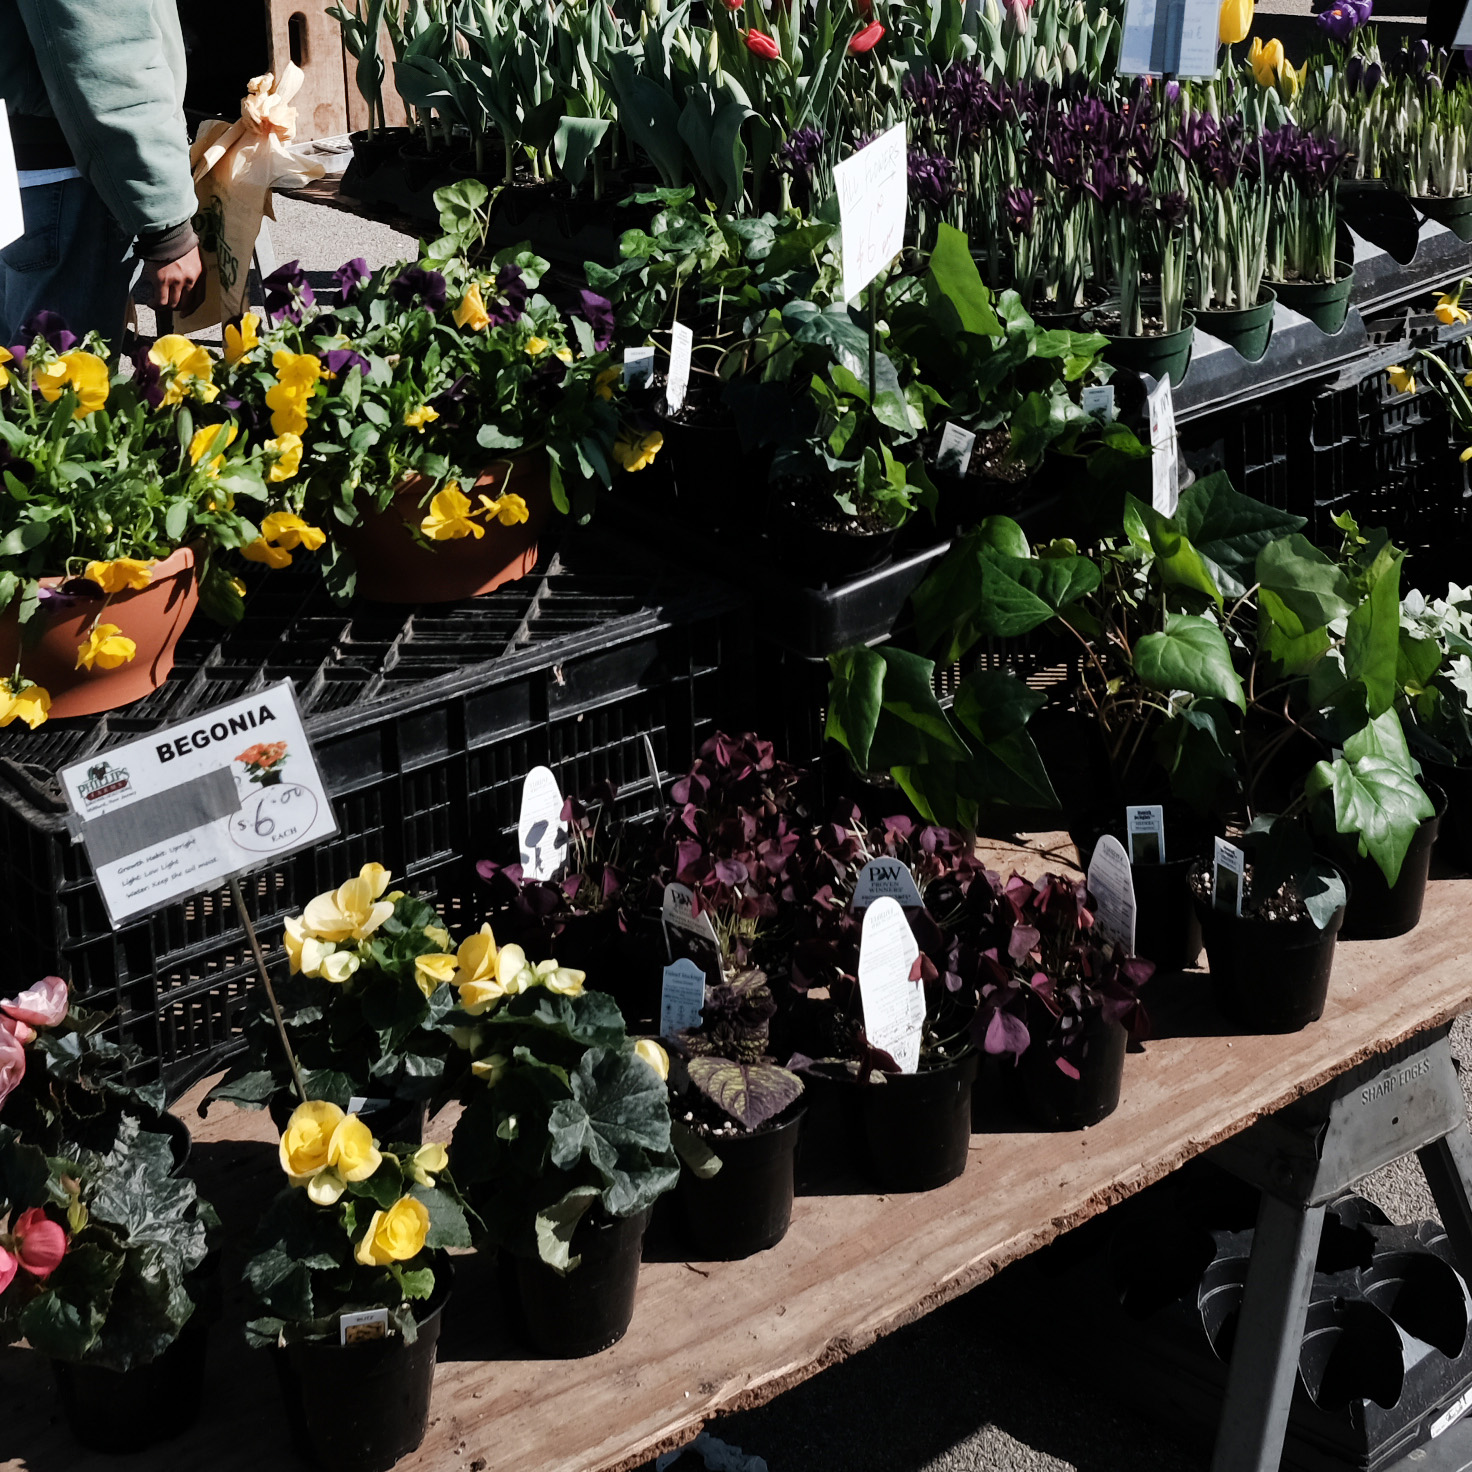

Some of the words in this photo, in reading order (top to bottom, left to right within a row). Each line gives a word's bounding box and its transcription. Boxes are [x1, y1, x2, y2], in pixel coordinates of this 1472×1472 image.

[156, 704, 276, 763] BEGONIA
[78, 768, 130, 798] PHILLIPS
[272, 827, 297, 842] EACH
[117, 860, 144, 874] Growth
[169, 838, 197, 856] Upright
[144, 867, 159, 880] Low
[161, 859, 179, 873] Light
[1361, 1077, 1397, 1105] SHARP
[1399, 1058, 1430, 1087] EDGES
